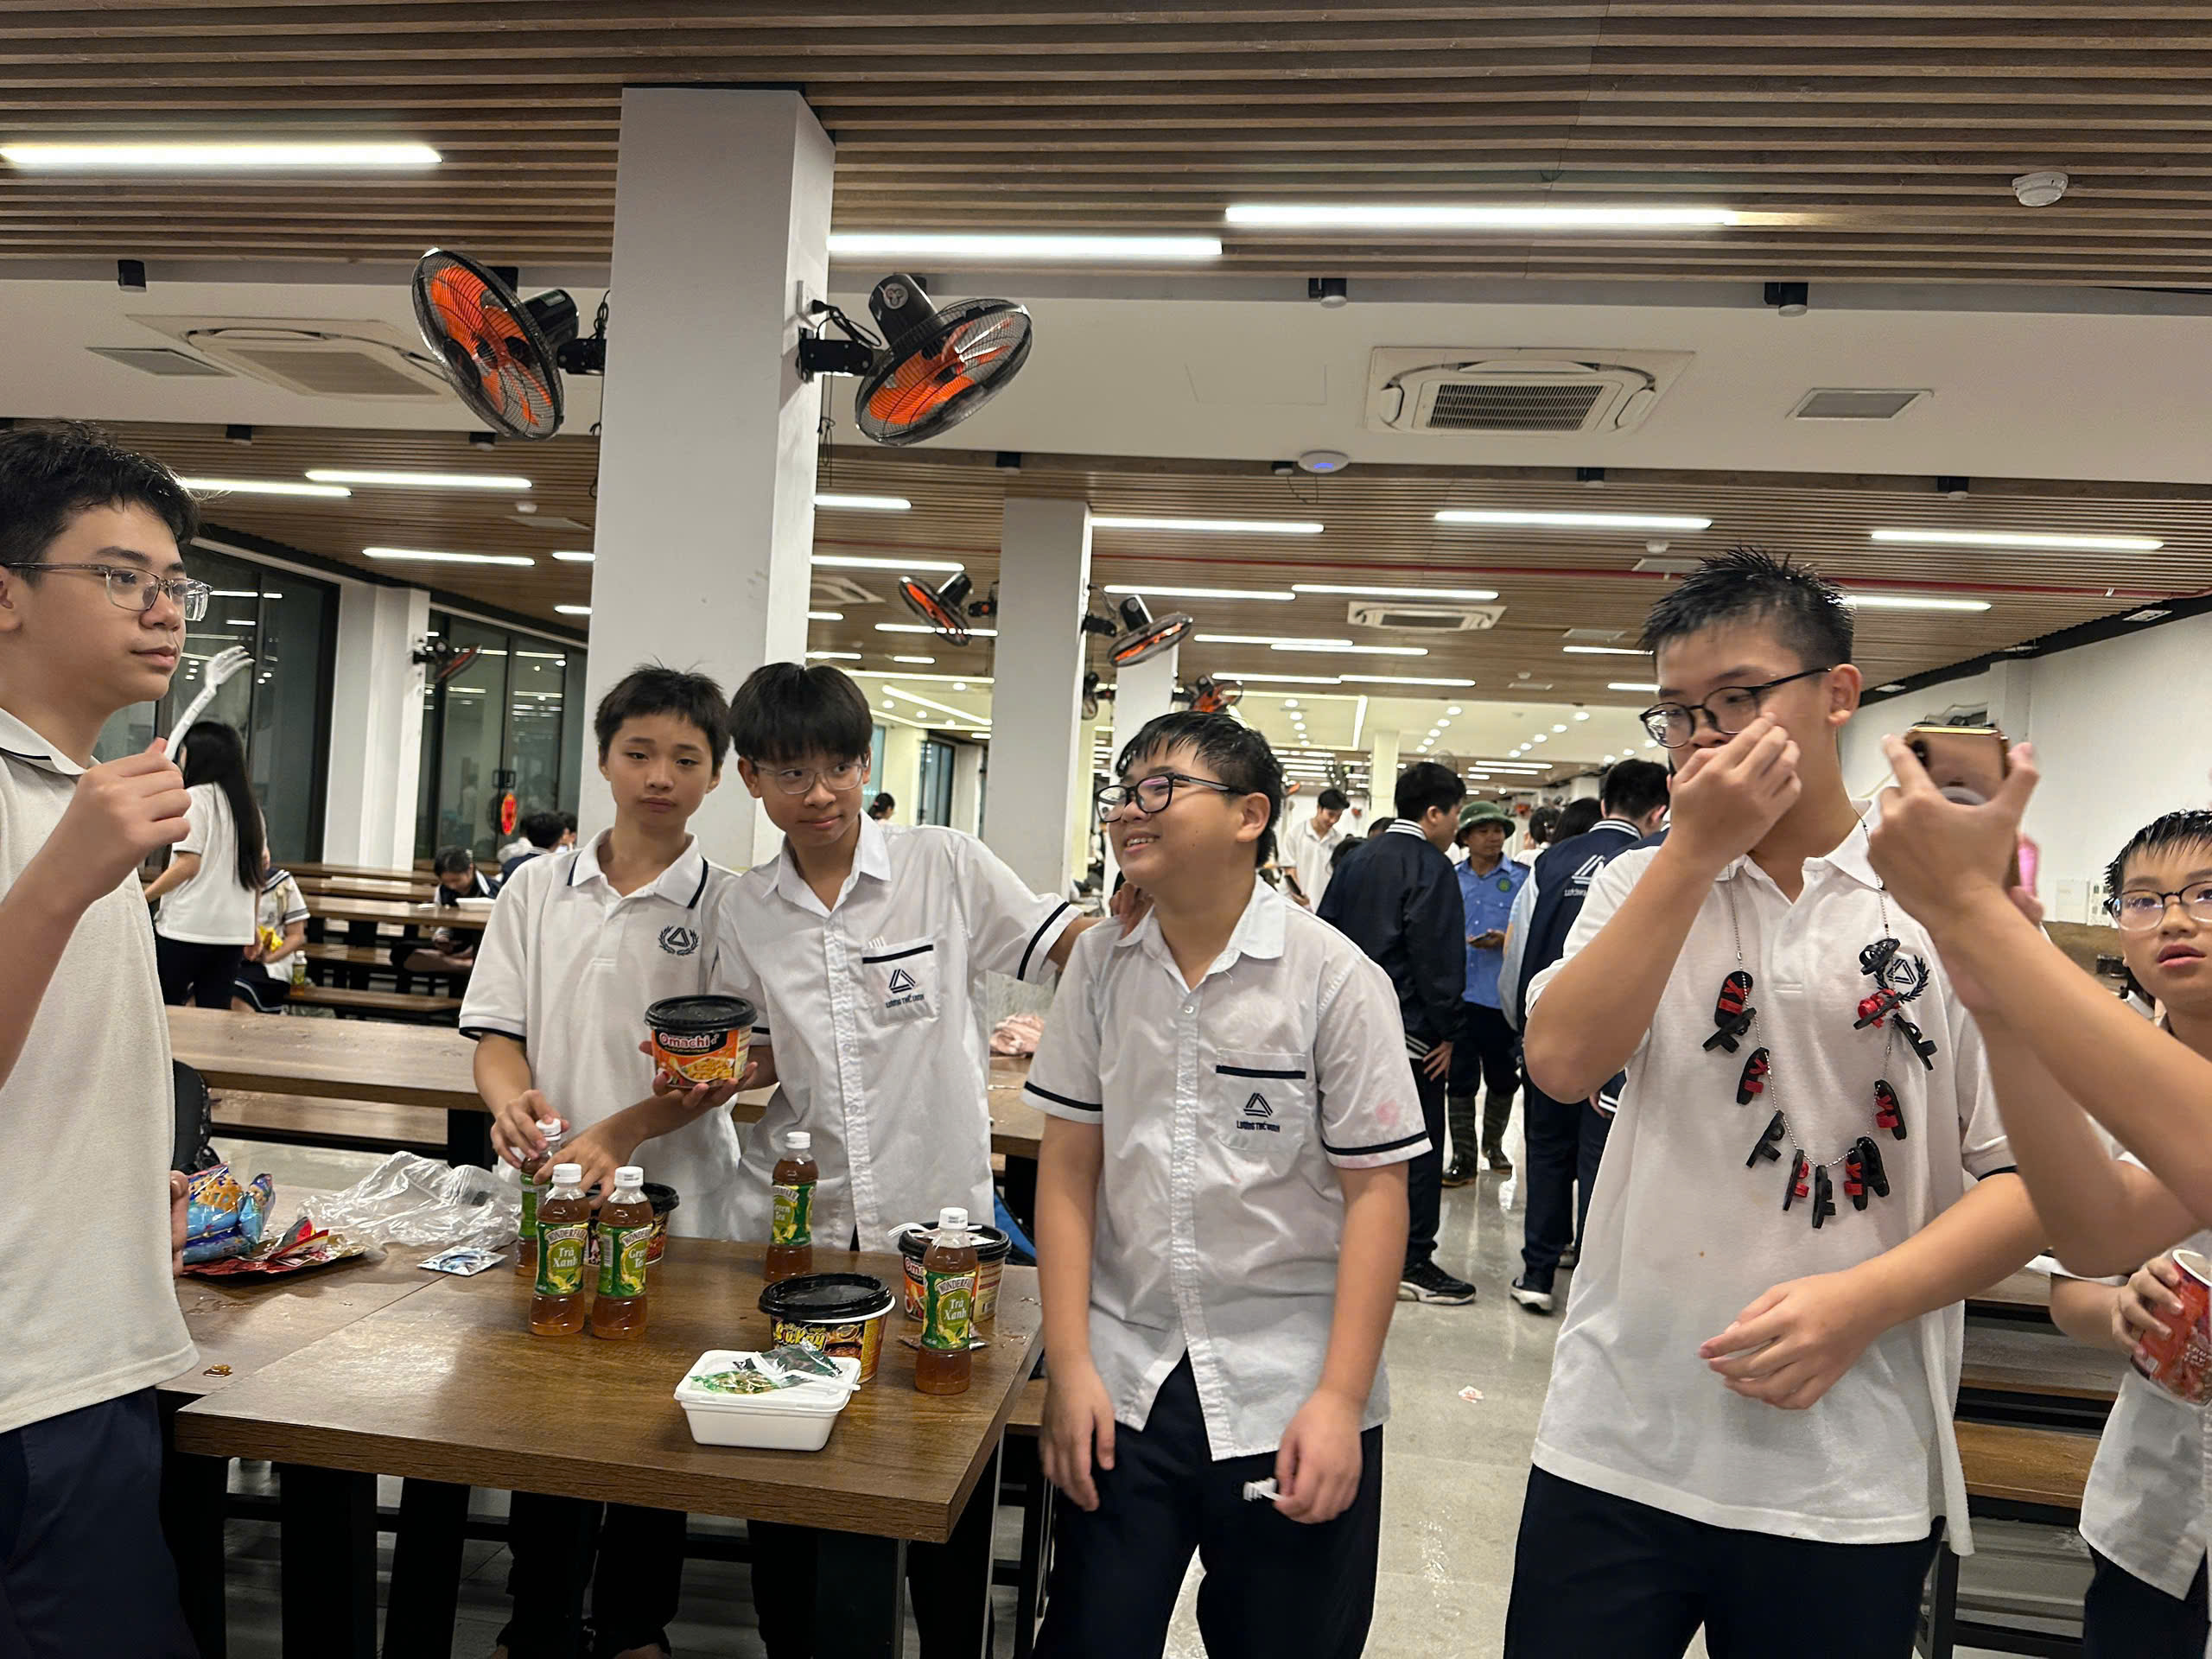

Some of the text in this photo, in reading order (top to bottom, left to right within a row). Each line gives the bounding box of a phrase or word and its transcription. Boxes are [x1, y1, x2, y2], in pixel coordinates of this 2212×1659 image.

[659, 1033, 710, 1048] Omachi
[553, 1256, 578, 1268] Xanh
[904, 1257, 925, 1276] Oma
[944, 1308, 967, 1320] Xanh
